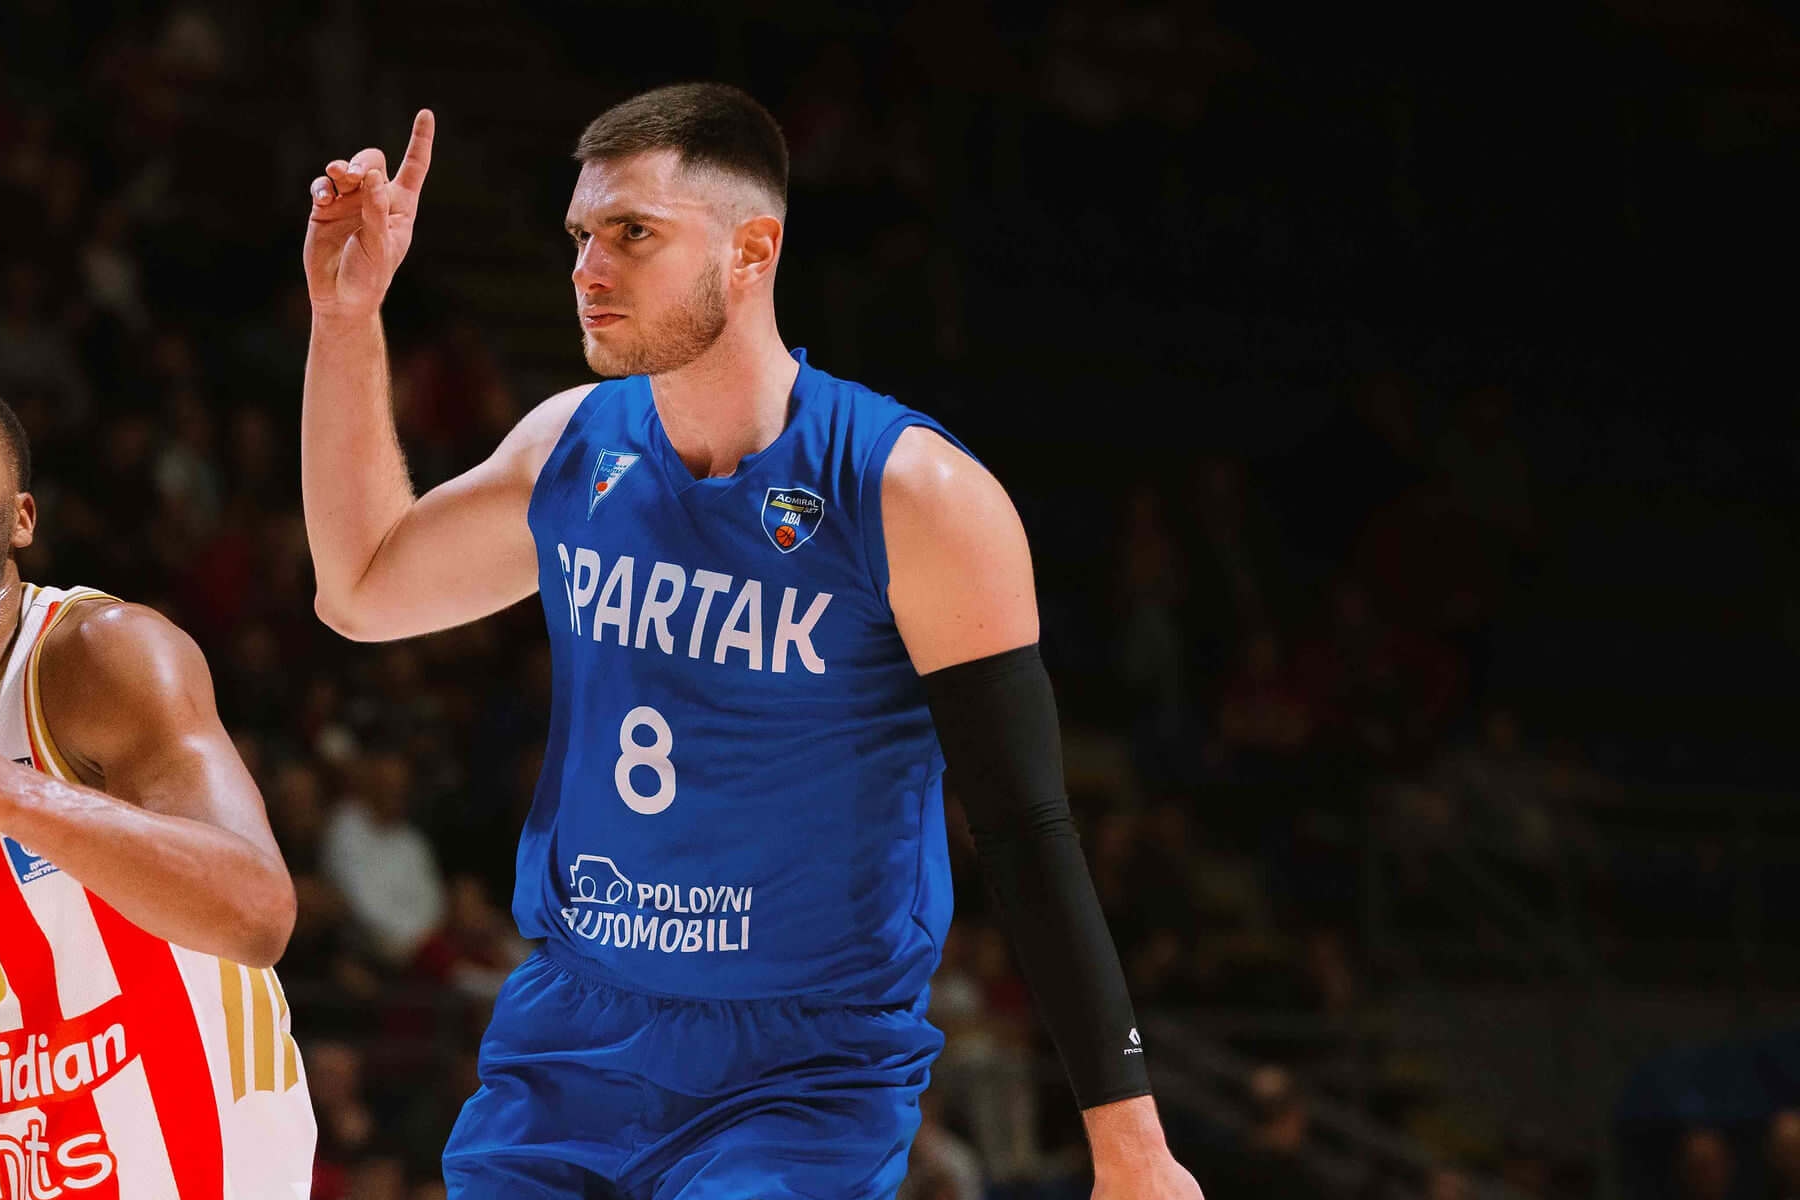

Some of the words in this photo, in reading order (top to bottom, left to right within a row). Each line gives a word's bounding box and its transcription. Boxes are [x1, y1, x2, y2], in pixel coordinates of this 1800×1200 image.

[781, 511, 801, 526] ABA
[615, 706, 676, 815] 8
[637, 883, 752, 913] POLOVNI
